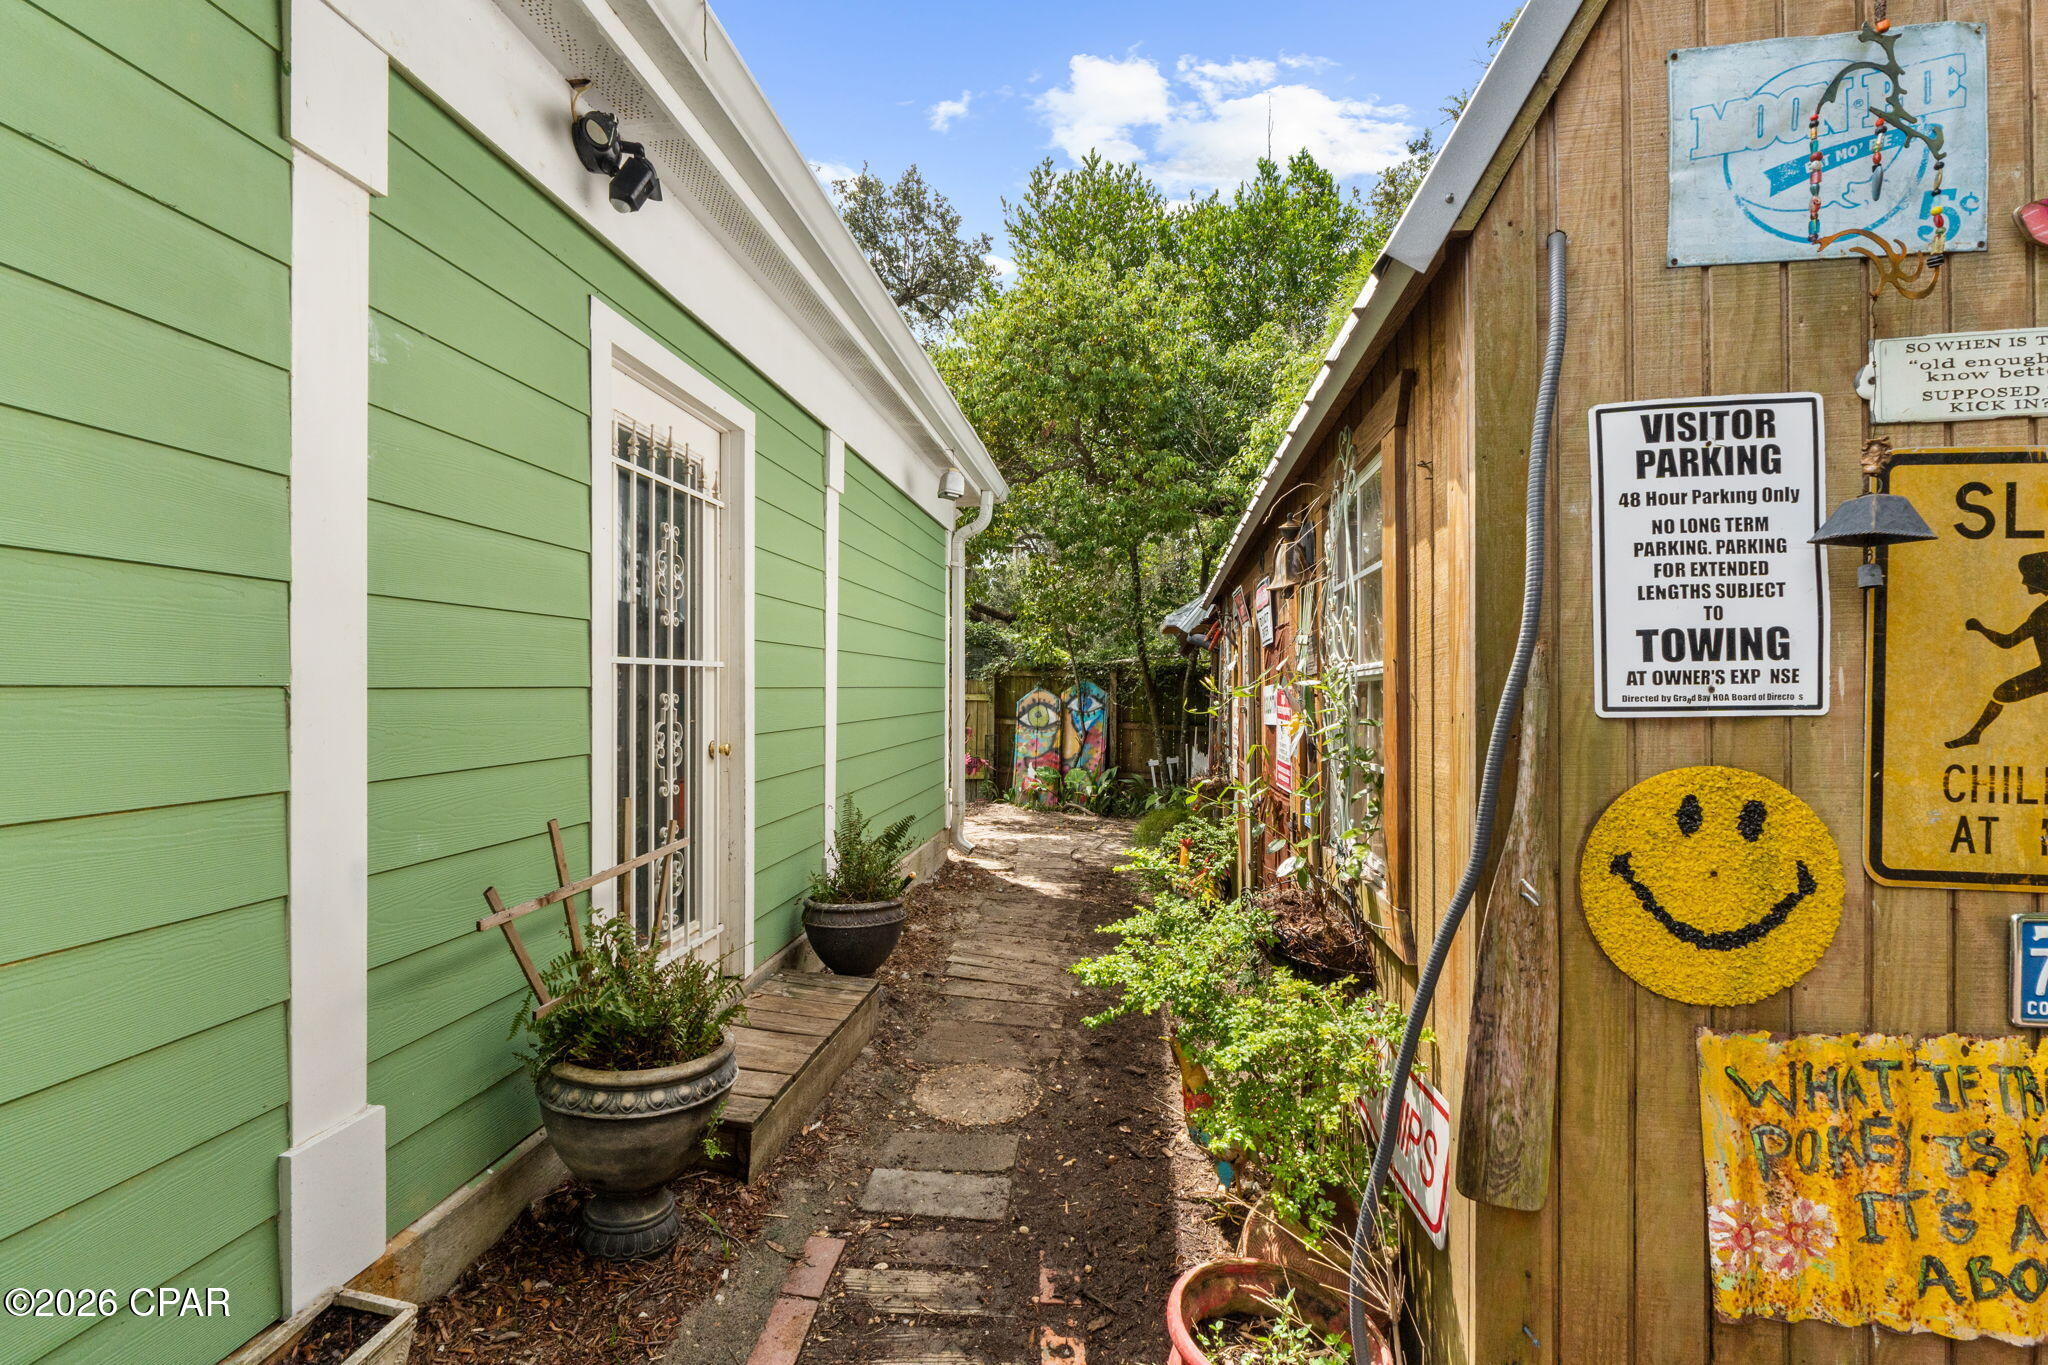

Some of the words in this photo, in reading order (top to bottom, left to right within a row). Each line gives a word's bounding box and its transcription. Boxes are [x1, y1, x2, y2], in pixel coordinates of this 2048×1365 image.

[1690, 77, 1854, 160] MOON
[1805, 155, 1830, 173] ET
[1905, 342, 1931, 353] SO
[1936, 338, 2001, 352] WHEN
[2008, 336, 2027, 347] IS
[1926, 370, 1989, 382] know
[1999, 366, 2048, 379] bett
[1922, 385, 2040, 402] SUPPOSED
[1950, 400, 2007, 413] KICK
[2014, 398, 2048, 410] IN?
[1640, 408, 1776, 443] VISITOR
[1636, 444, 1782, 479] PARKING
[1618, 492, 1641, 507] 48
[1646, 490, 1688, 506] Hour
[1692, 487, 1757, 505] Parking
[1762, 486, 1800, 503] Only
[1953, 481, 2045, 540] SL
[1652, 518, 1675, 535] NO
[1680, 517, 1720, 533] LONG
[1725, 516, 1769, 532] TERM
[1633, 540, 1712, 557] PARKING.
[1716, 538, 1787, 554] PARKING
[1654, 562, 1685, 578] FOR
[1691, 561, 1769, 577] EXTENDED
[1638, 583, 1711, 600] LENGTHS
[1715, 582, 1786, 599] SUBJECT
[1704, 605, 1723, 620] TO
[1636, 626, 1790, 662] TOWING
[1626, 670, 1647, 686] AT
[1652, 669, 1725, 685] OWNER'S
[1730, 668, 1800, 684] EXPNSE
[1622, 694, 1659, 703] Directed
[1661, 694, 1671, 703] by
[1673, 694, 1696, 704] Grand
[1697, 693, 1710, 702] Bay
[1713, 693, 1730, 701] HOA
[1732, 693, 1757, 701] Board
[1758, 693, 1766, 701] of
[1943, 764, 2048, 805] CHIL
[1949, 815, 1999, 854] AT
[1725, 1059, 1903, 1118] WHAT
[1917, 1059, 1981, 1114] IF
[1931, 1129, 2009, 1177] IS
